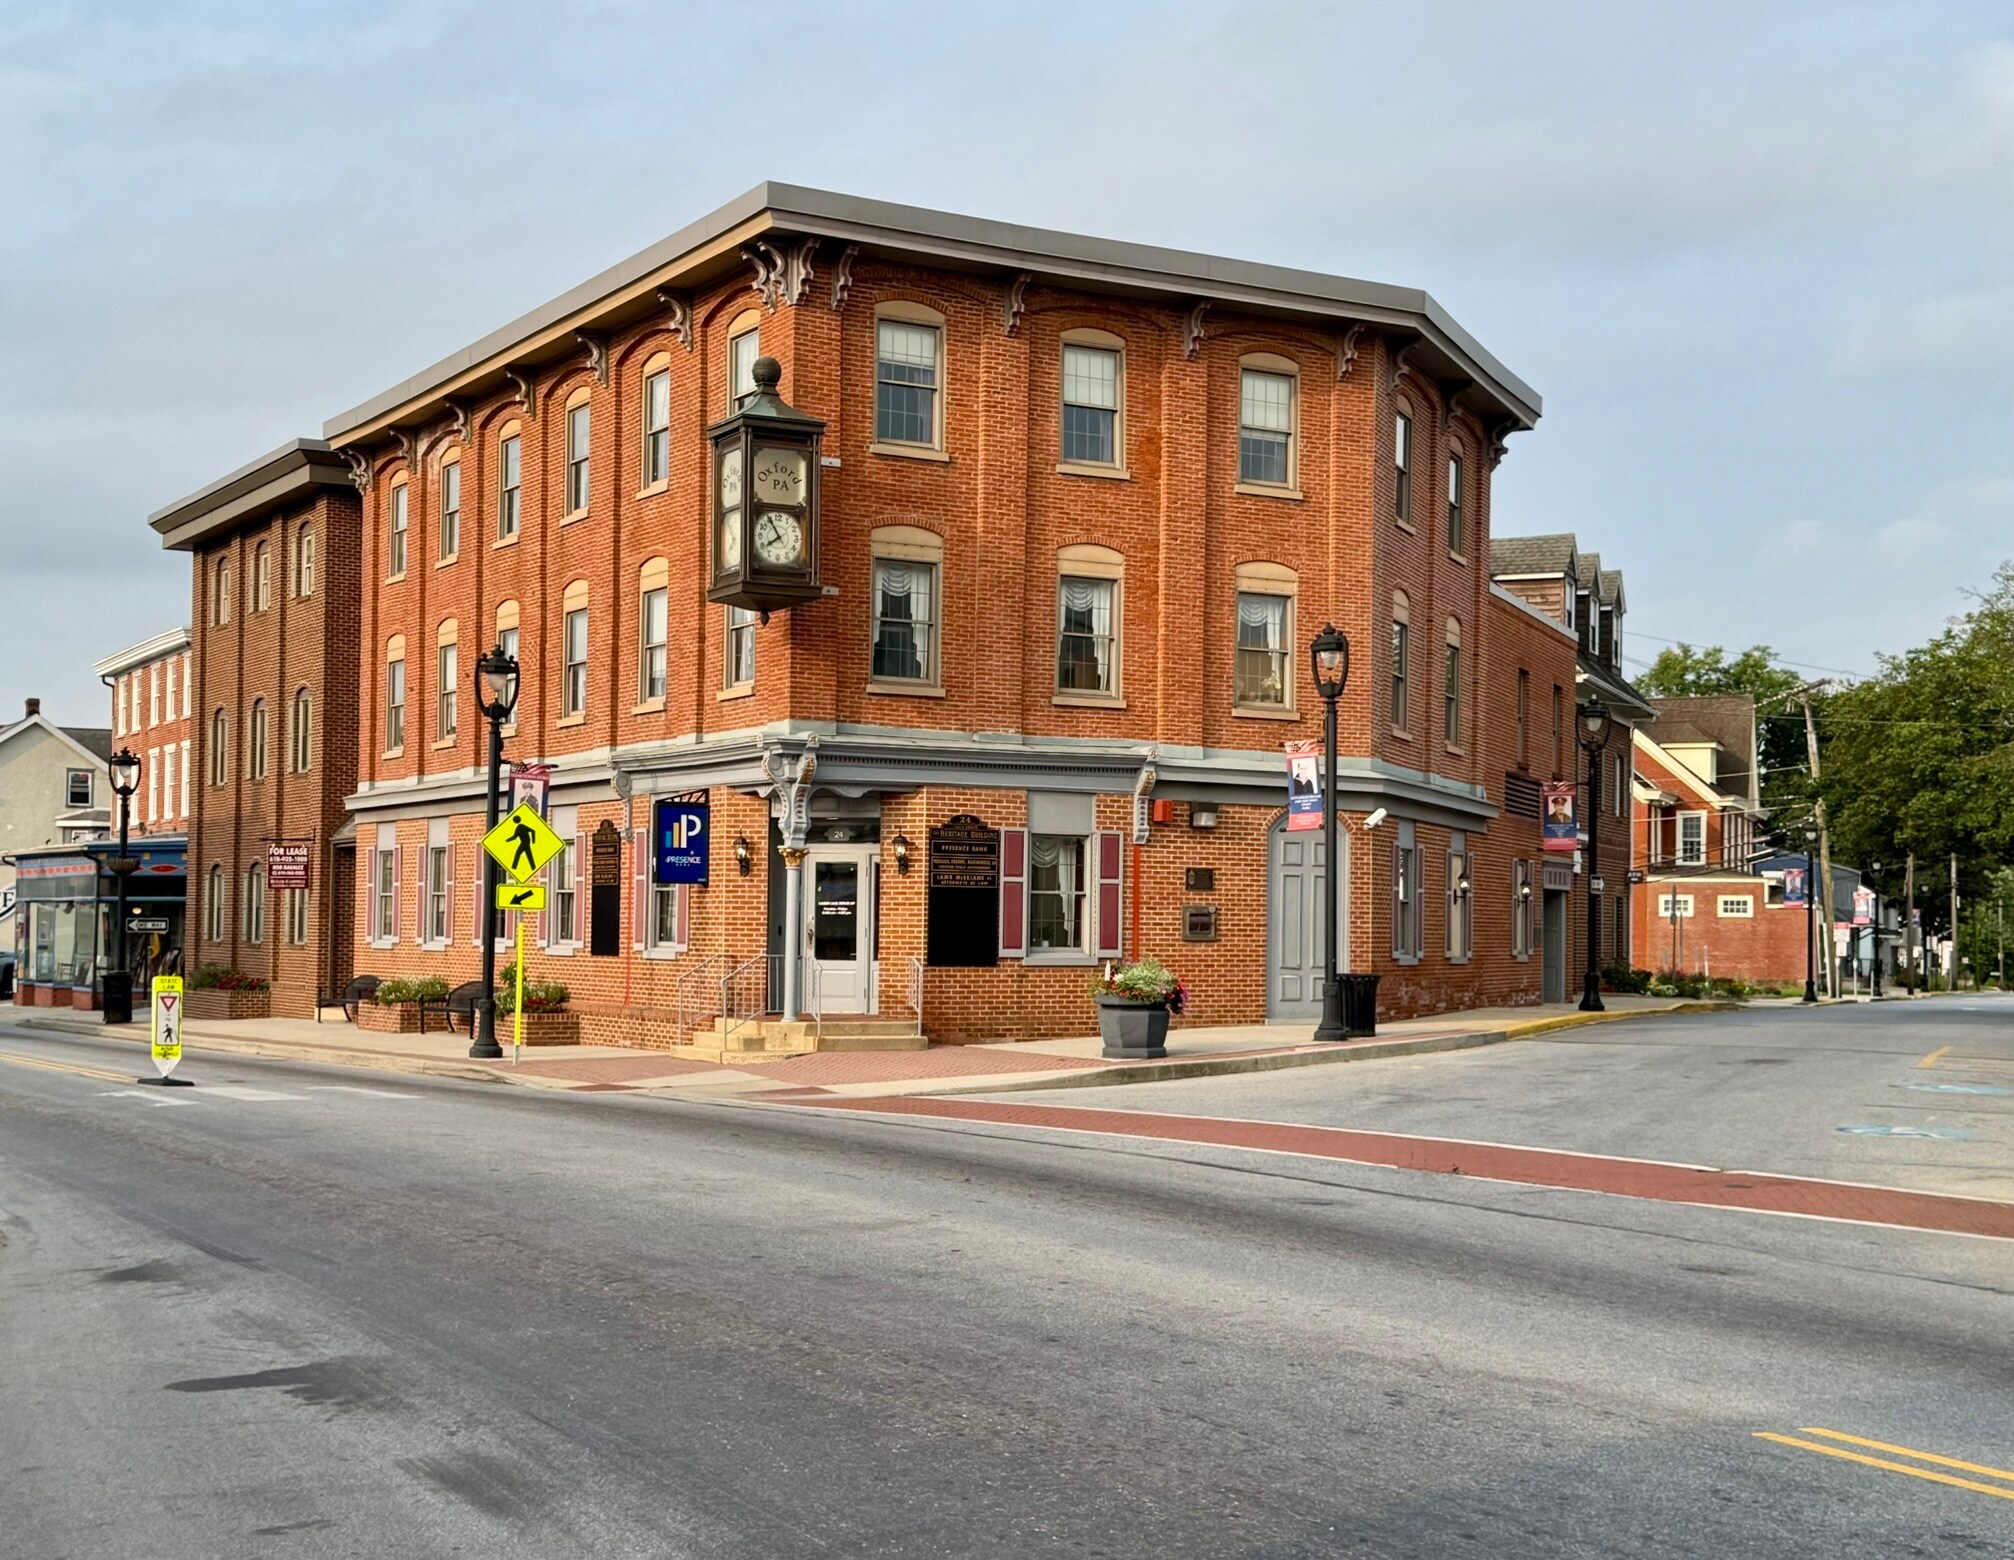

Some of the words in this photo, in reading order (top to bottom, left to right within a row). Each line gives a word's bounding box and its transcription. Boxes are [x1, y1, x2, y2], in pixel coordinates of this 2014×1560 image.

[758, 461, 802, 485] Oxford
[773, 479, 789, 491] PA
[960, 816, 971, 824] 24
[940, 830, 968, 839] HERITAGE
[970, 831, 998, 839] BUILDING
[269, 847, 285, 855] FOR
[286, 847, 308, 855] LEASE
